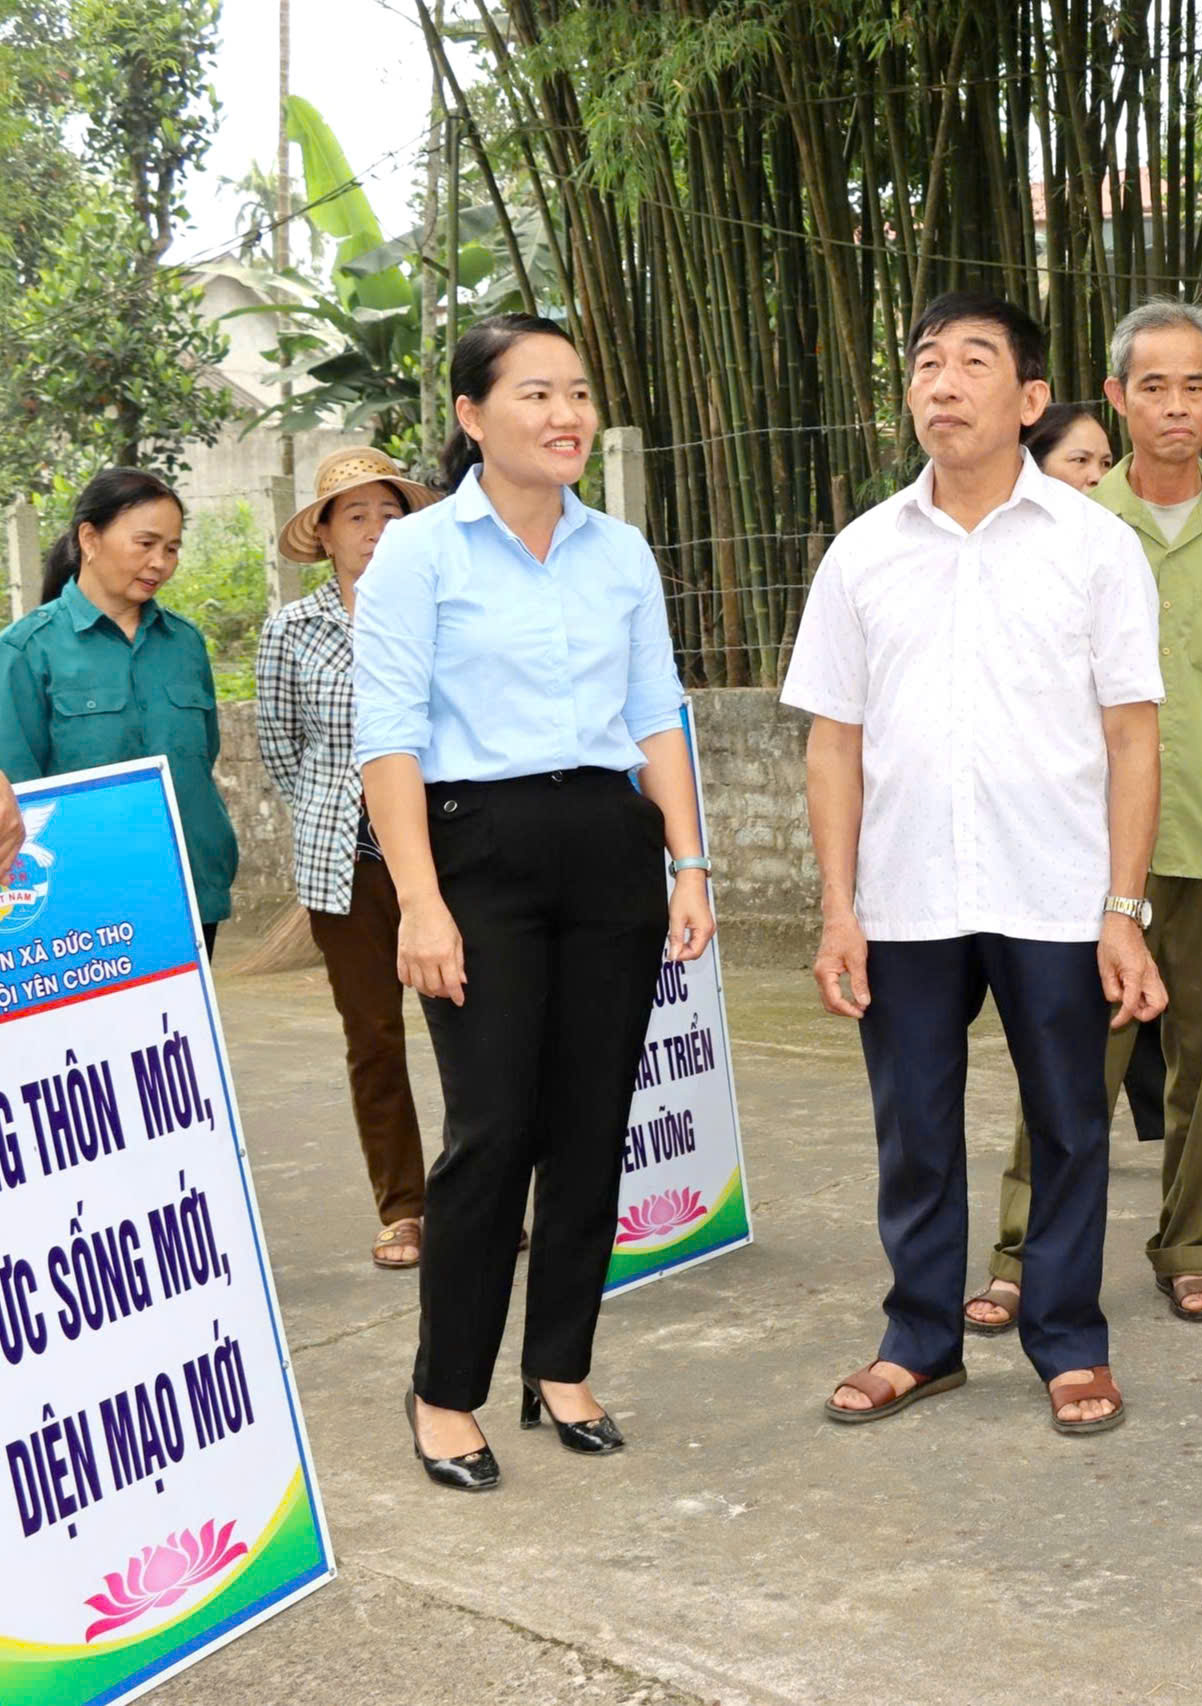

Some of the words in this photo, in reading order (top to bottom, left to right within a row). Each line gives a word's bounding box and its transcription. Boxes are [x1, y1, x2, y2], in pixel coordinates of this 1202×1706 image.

[19, 938, 49, 967] XÃ
[52, 930, 94, 959] ĐỨC
[96, 922, 134, 946] THỌ
[0, 982, 18, 1012] ỘI
[21, 973, 59, 1000] YÊN
[63, 956, 132, 990] CƯỜNG
[663, 1012, 715, 1081] TRIỂN
[20, 1048, 126, 1176] THÔN
[131, 1012, 215, 1140] MỚI,
[648, 1105, 696, 1164] VỮNG
[48, 1200, 153, 1341] SỐNG
[148, 1169, 232, 1300] MỚI,
[5, 1402, 103, 1540] DIỆN
[99, 1372, 185, 1494] MẠO
[182, 1319, 254, 1450] MỚI
